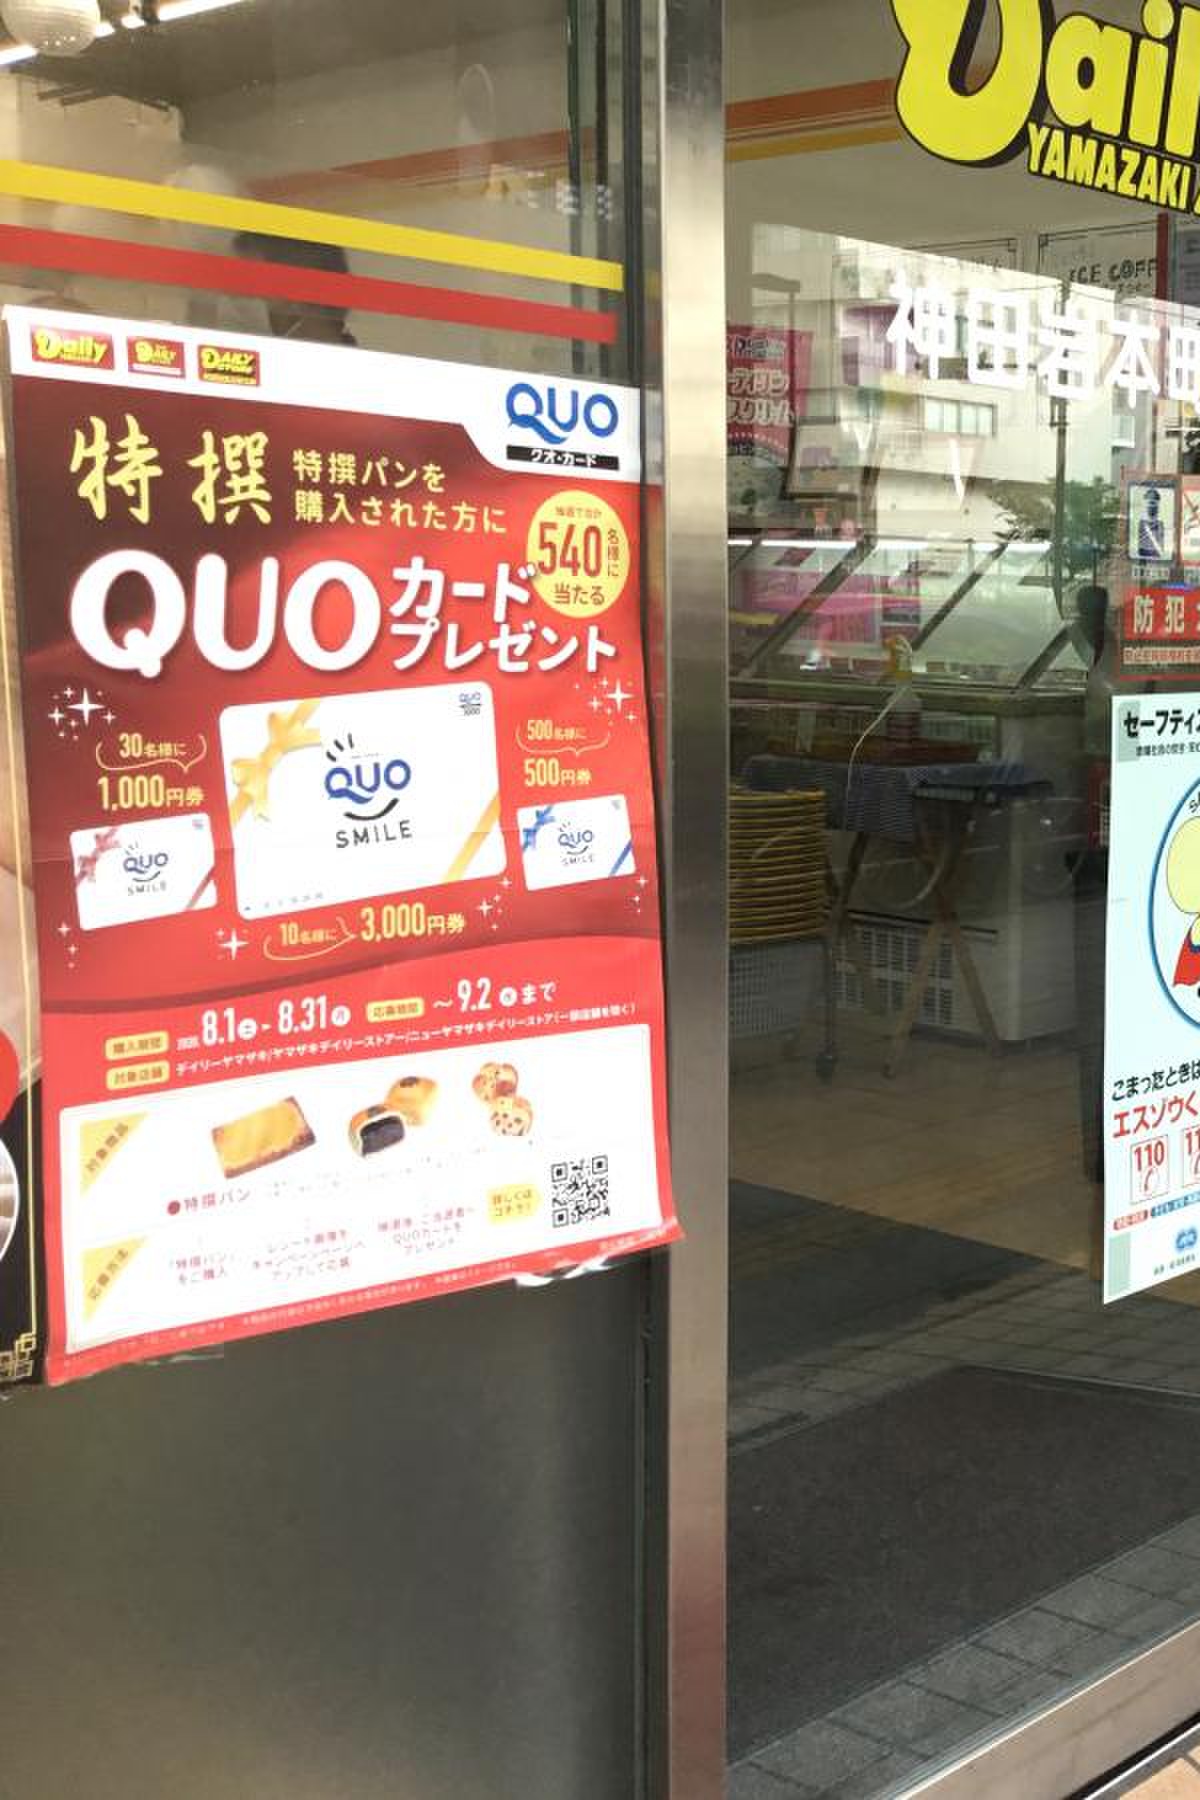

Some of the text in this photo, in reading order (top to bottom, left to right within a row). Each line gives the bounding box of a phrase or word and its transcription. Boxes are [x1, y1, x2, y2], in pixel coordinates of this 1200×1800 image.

[1027, 121, 1198, 213] YAMAZAKI
[506, 383, 618, 444] QUO
[293, 449, 446, 494] 特撰パンを
[531, 448, 598, 468] クオ・カード
[294, 490, 507, 534] 購入された方に
[538, 522, 601, 576] 540
[607, 529, 620, 577] 名様に
[390, 557, 535, 623] カード
[554, 583, 605, 605] 当たる
[70, 549, 382, 679] QUO
[389, 620, 617, 675] プレゼント
[324, 759, 412, 804] QUO
[524, 758, 591, 786] 500円券
[336, 820, 412, 848] SMILE
[558, 830, 593, 848] QUO
[123, 852, 169, 874] QUO
[1134, 1140, 1165, 1172] 110
